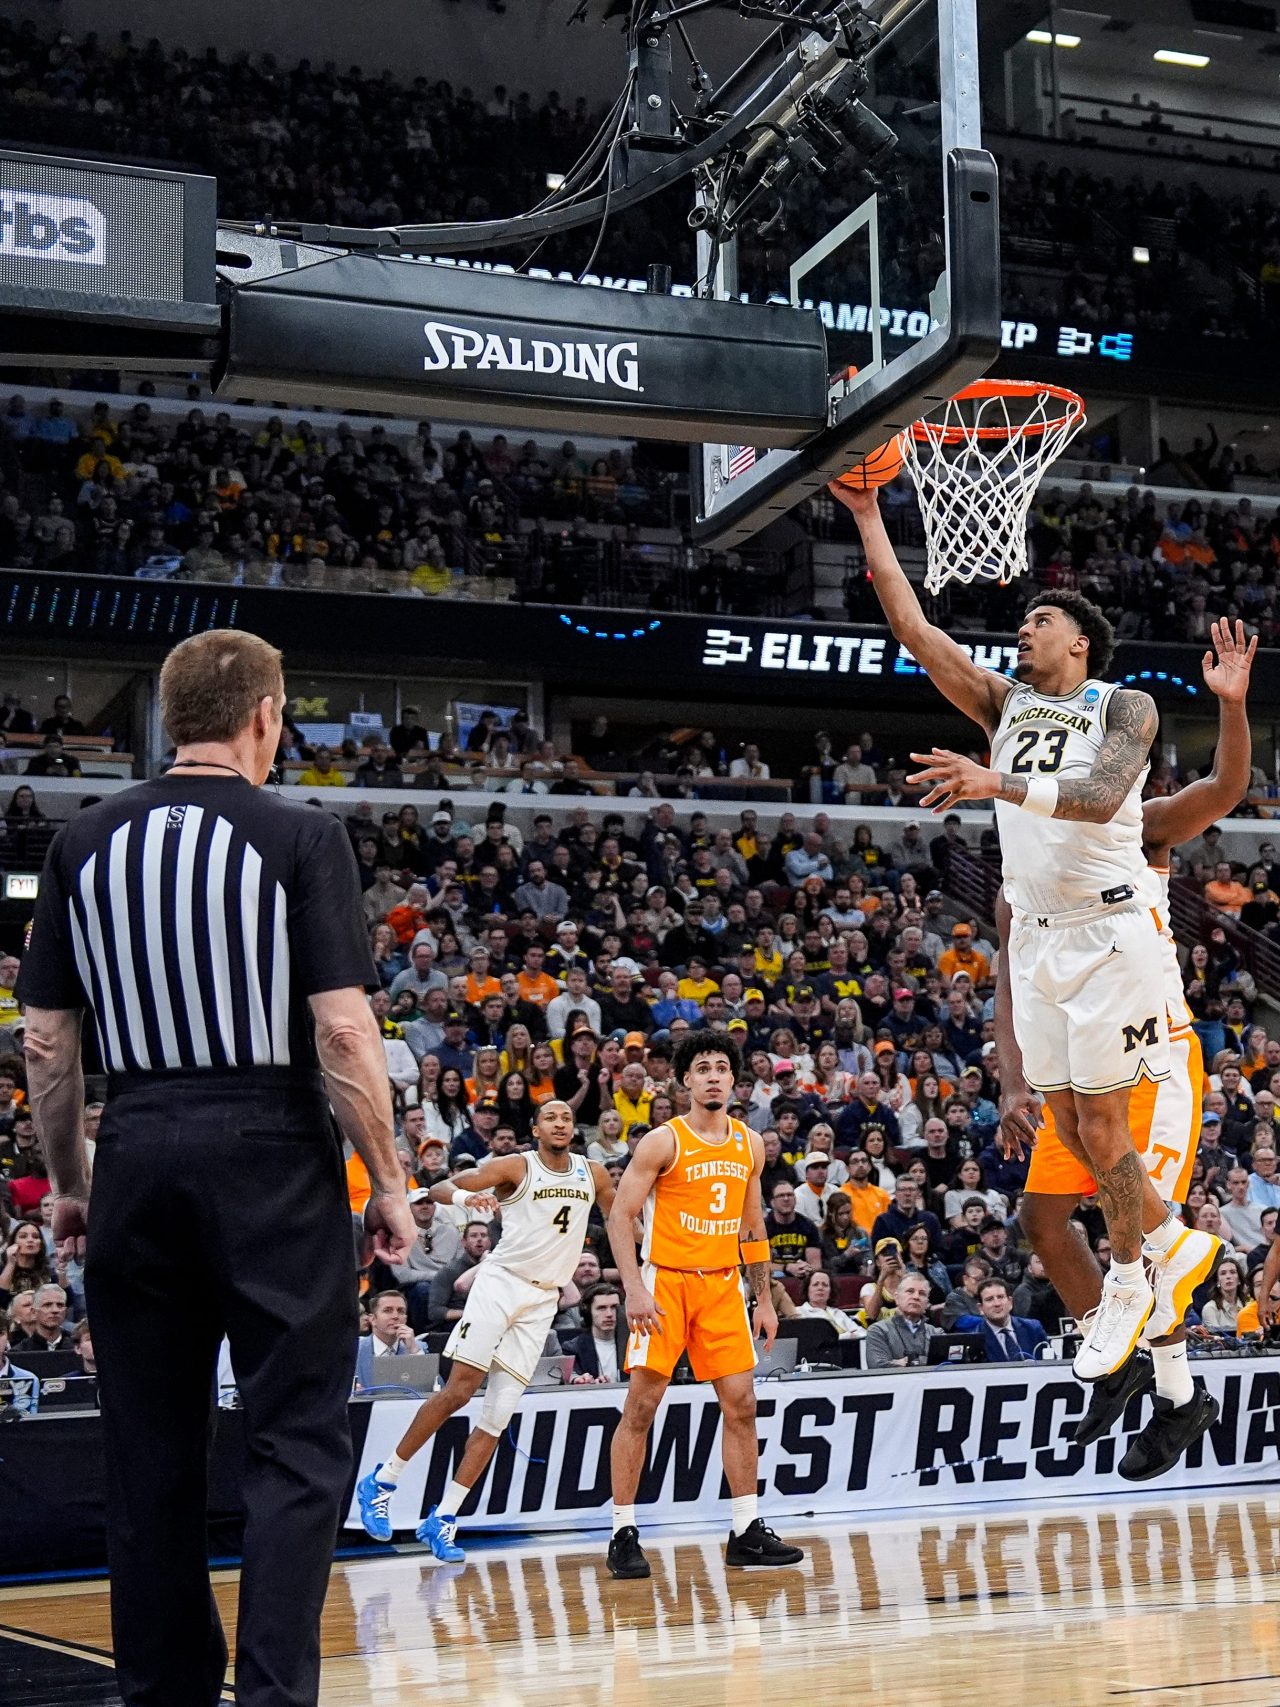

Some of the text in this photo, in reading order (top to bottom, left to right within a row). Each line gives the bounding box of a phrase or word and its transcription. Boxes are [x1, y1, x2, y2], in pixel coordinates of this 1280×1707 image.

[424, 321, 640, 392] SPALDING
[760, 632, 887, 675] ELITE
[1007, 707, 1092, 736] MICHIGAN
[1011, 729, 1069, 774] 23
[1037, 918, 1050, 928] M
[1121, 1016, 1159, 1053] M
[685, 1160, 749, 1182] TENNESSEE
[1147, 1143, 1181, 1181] T
[532, 1188, 590, 1202] MICHIGAN
[709, 1182, 727, 1214] 3
[553, 1205, 572, 1234] 4
